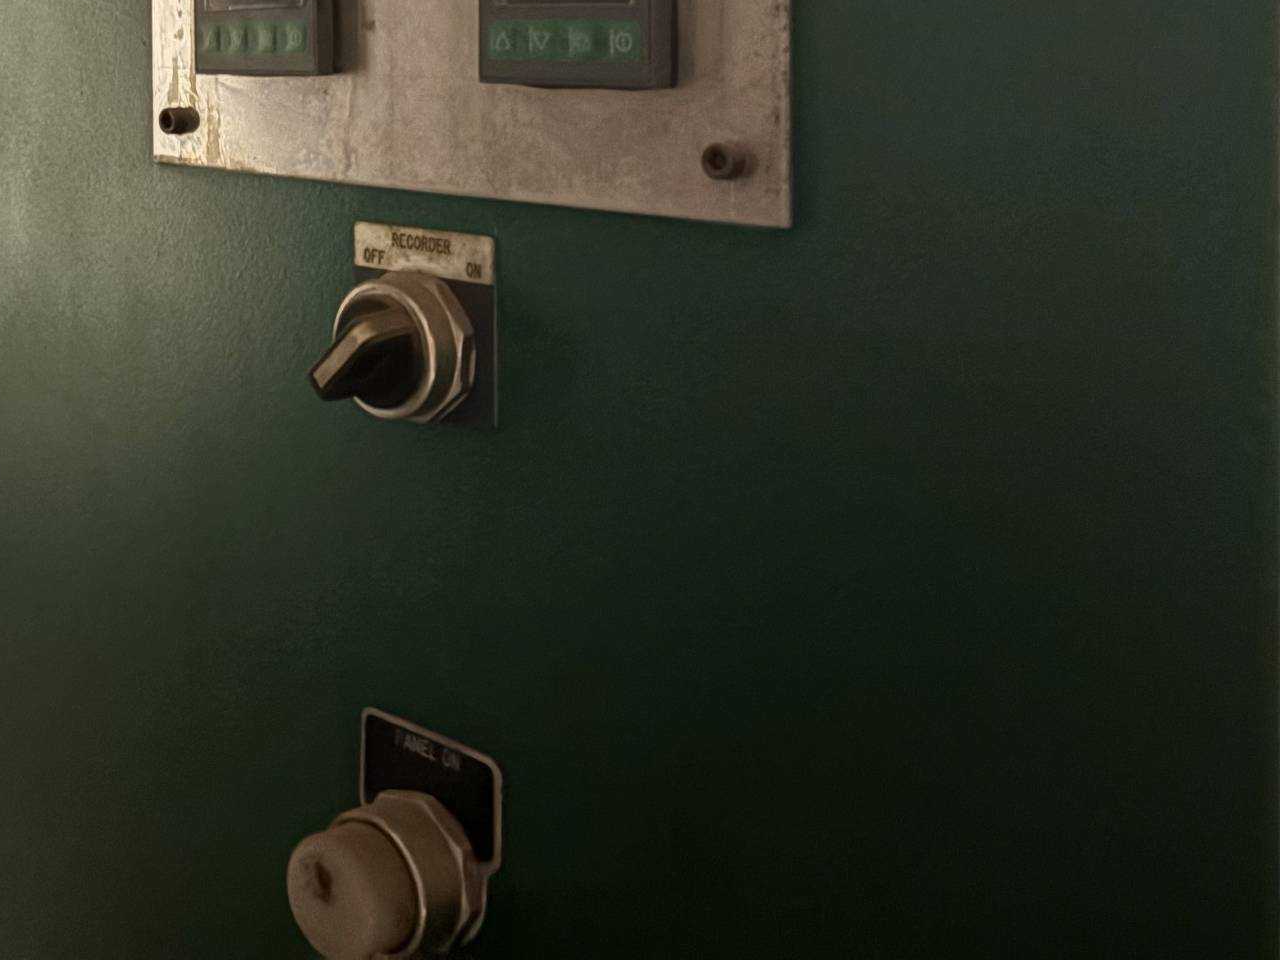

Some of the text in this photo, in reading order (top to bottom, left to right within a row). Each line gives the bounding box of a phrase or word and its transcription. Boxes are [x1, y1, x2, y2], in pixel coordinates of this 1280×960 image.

[391, 232, 452, 255] RECORDER
[364, 248, 482, 279] OFF ON
